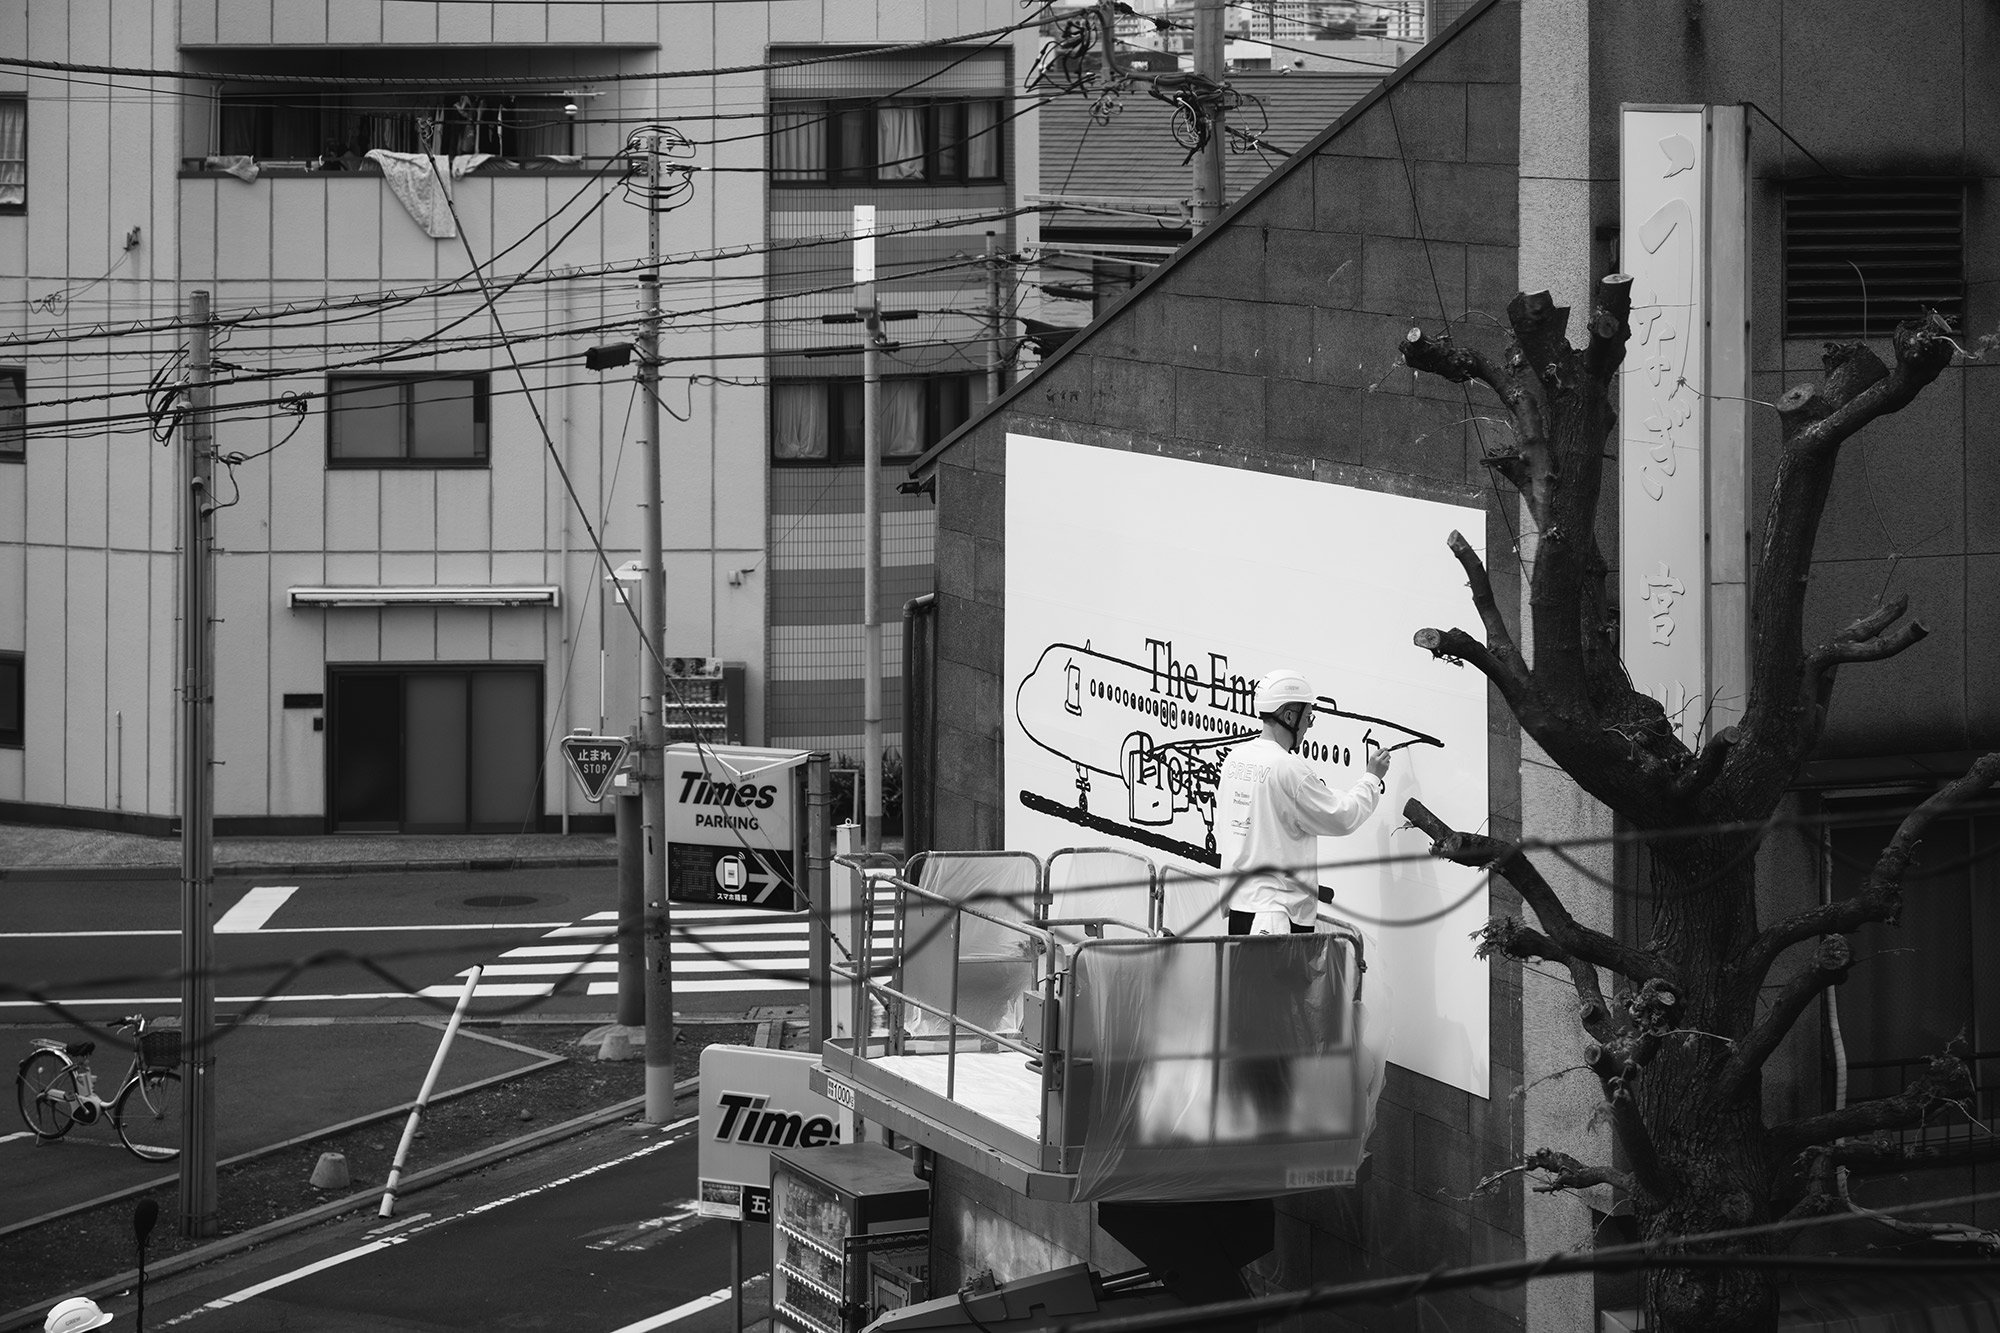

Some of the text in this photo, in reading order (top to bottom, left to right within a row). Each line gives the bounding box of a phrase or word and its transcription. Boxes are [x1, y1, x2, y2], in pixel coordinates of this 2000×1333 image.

[1144, 638, 1198, 703] The
[577, 749, 612, 761] 止まれ
[583, 763, 608, 774] STOP
[1226, 760, 1271, 784] CREW
[678, 771, 777, 809] Times
[695, 814, 759, 831] PARKING
[834, 1083, 851, 1104] 1000
[751, 1195, 770, 1215] 五
